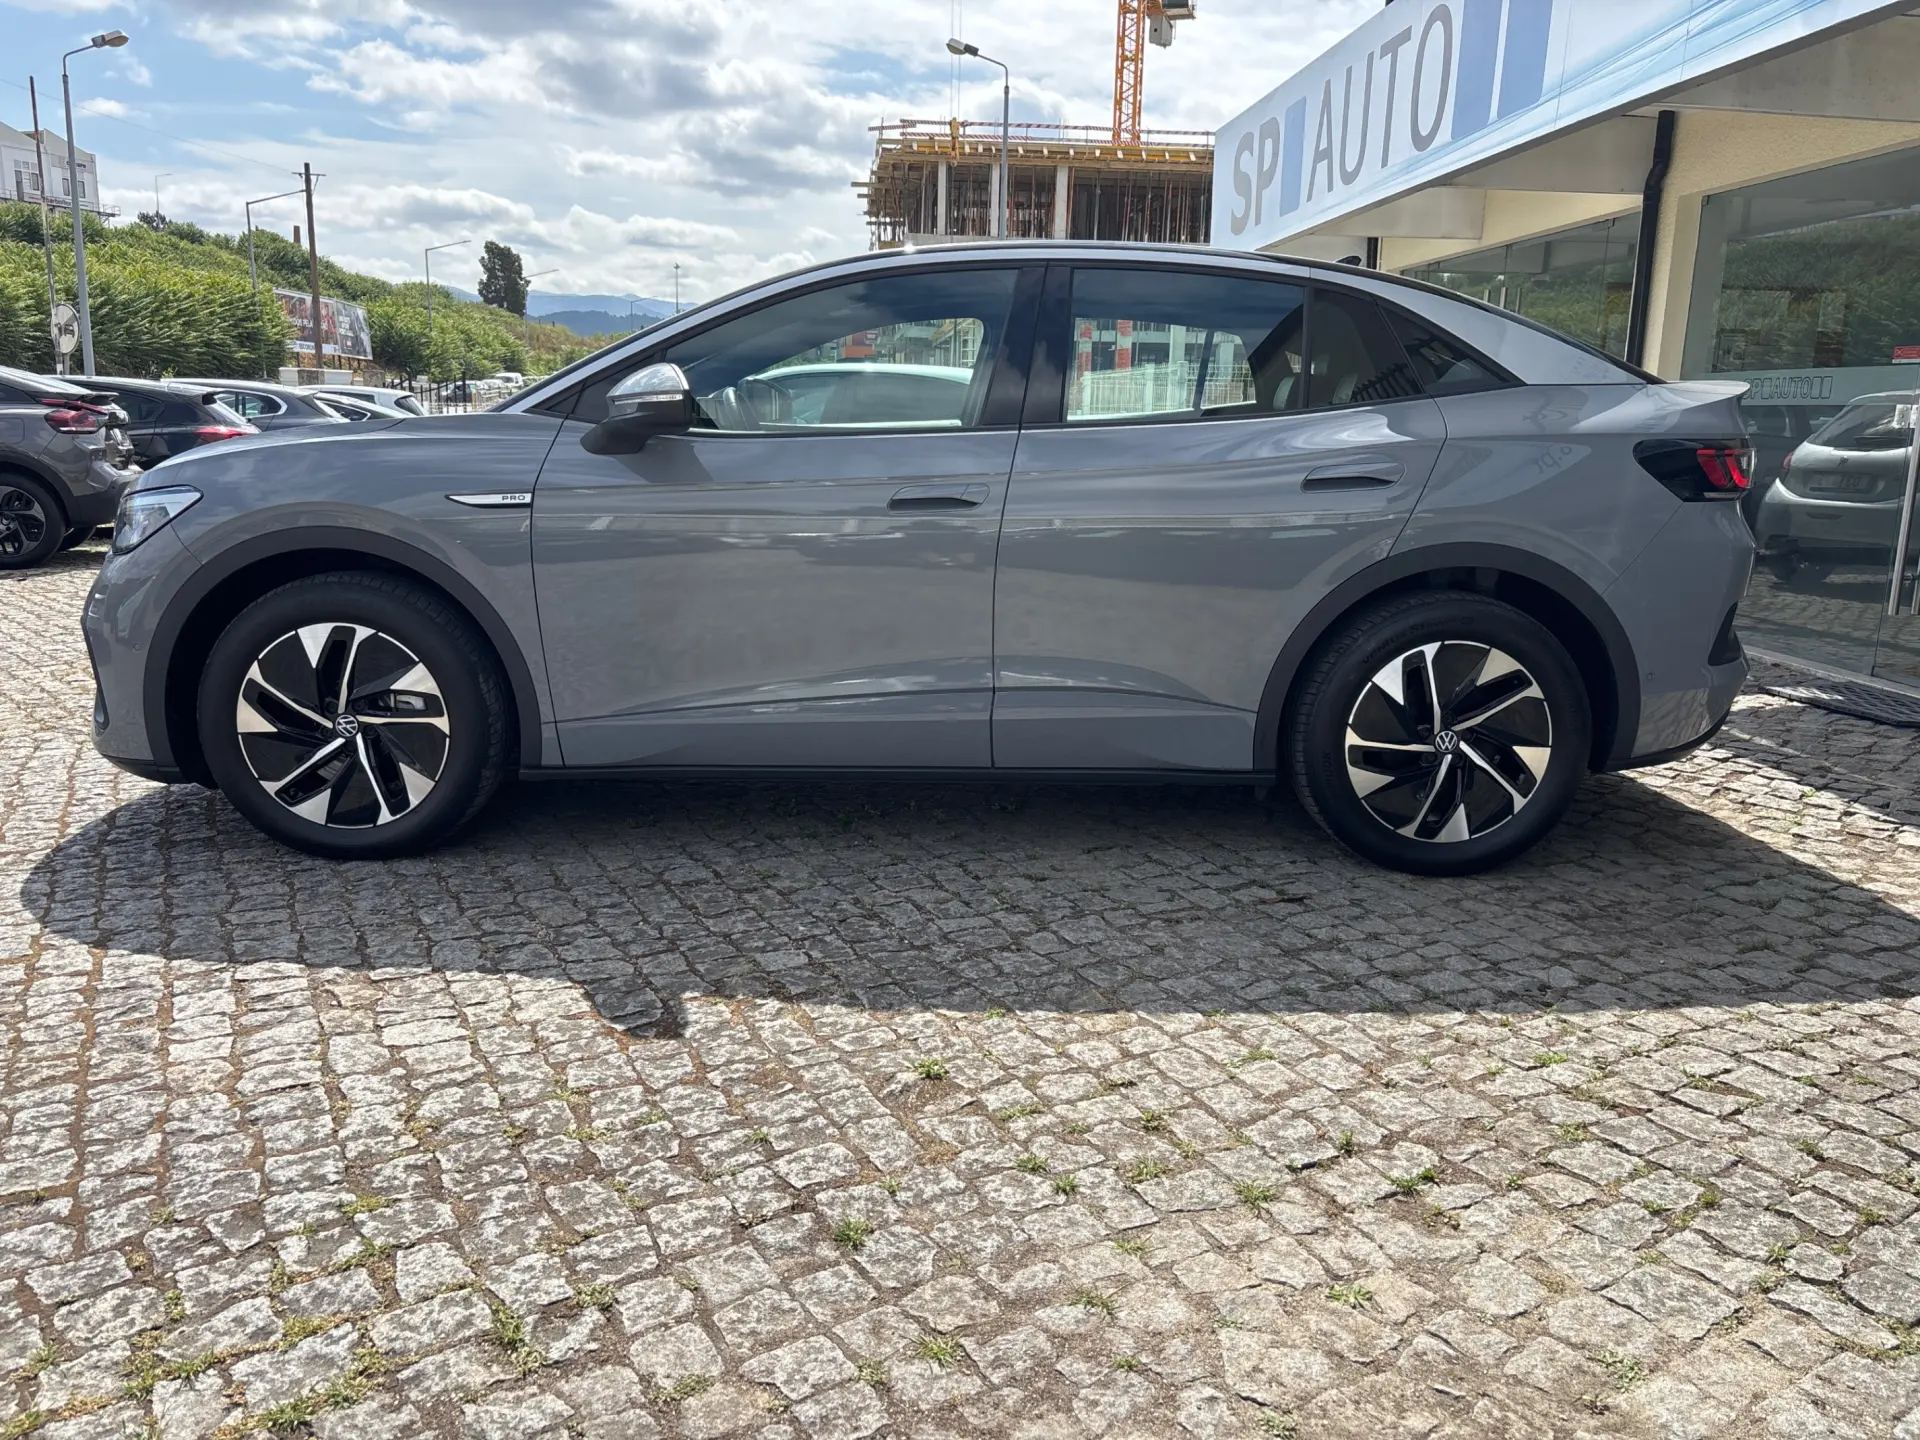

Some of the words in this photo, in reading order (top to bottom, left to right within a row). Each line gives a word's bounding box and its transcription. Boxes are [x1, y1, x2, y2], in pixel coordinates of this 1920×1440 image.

[1231, 116, 1280, 236] SP
[1306, 3, 1453, 203] AUTO
[1770, 376, 1811, 399] AUTO
